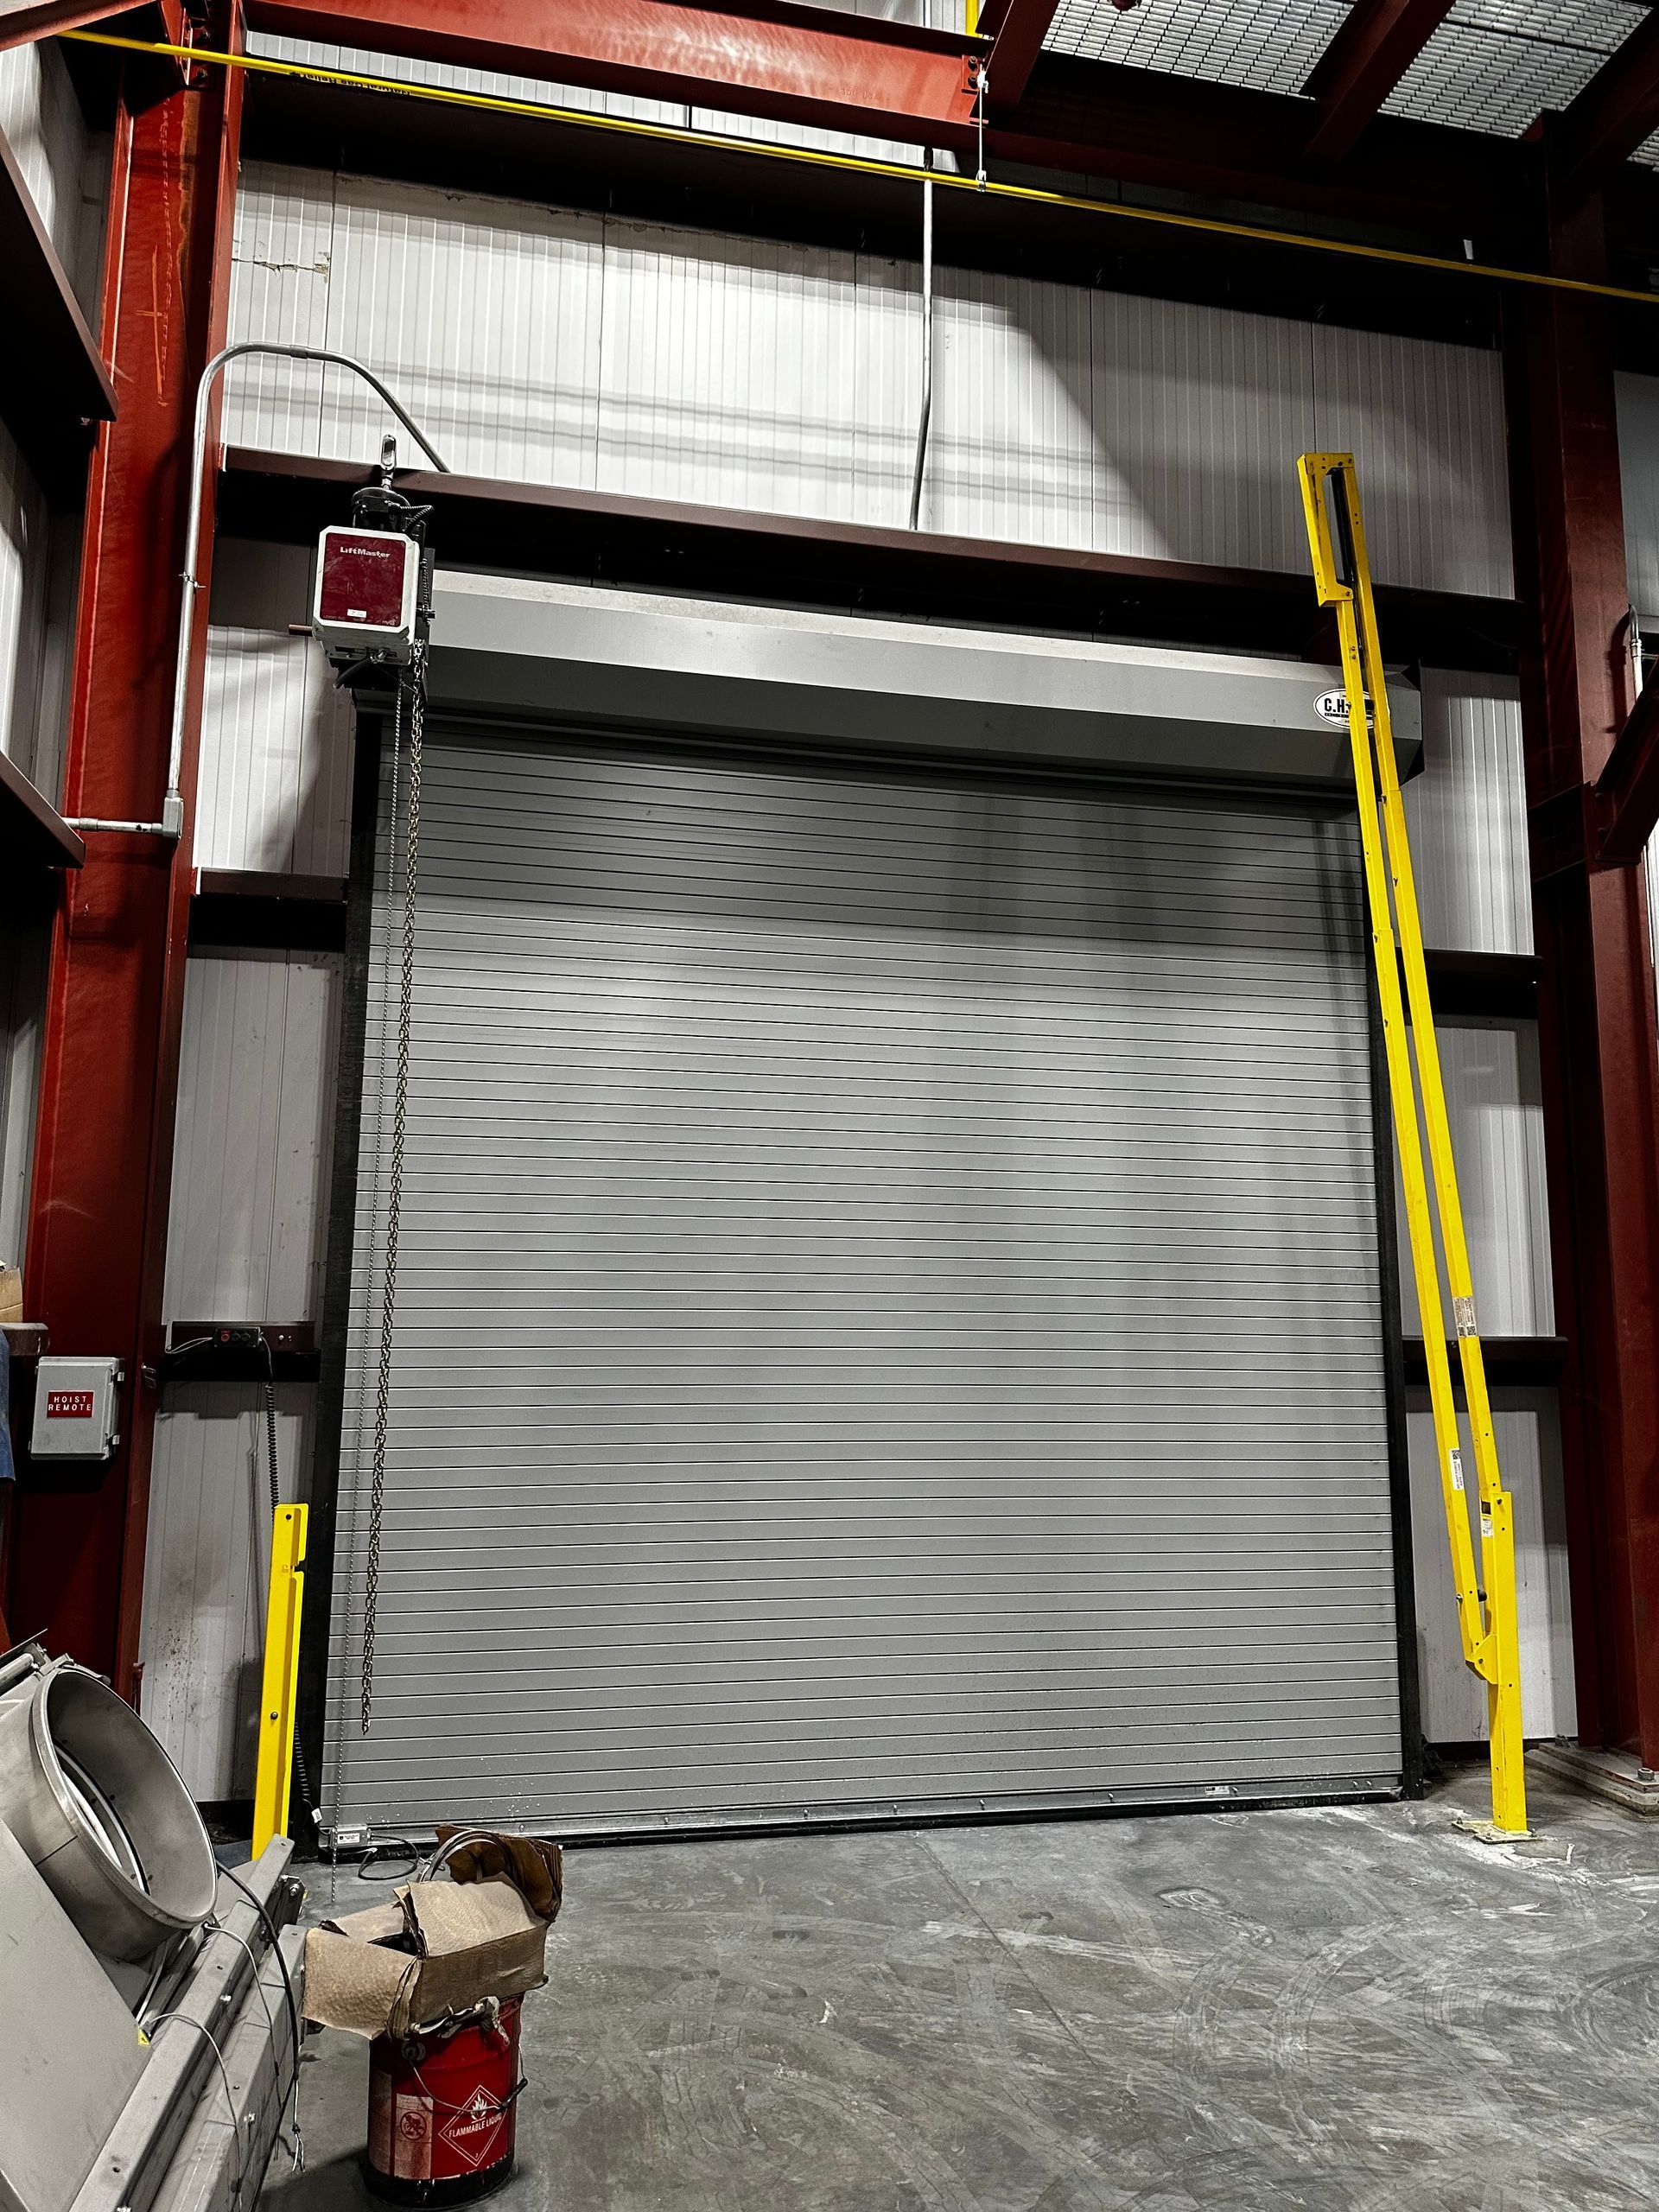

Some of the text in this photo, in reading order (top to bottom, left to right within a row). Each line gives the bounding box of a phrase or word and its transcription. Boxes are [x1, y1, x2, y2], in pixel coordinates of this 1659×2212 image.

[340, 546, 391, 558] LiftMaster
[448, 2113, 502, 2138] FLAMMABLE LIQUID
